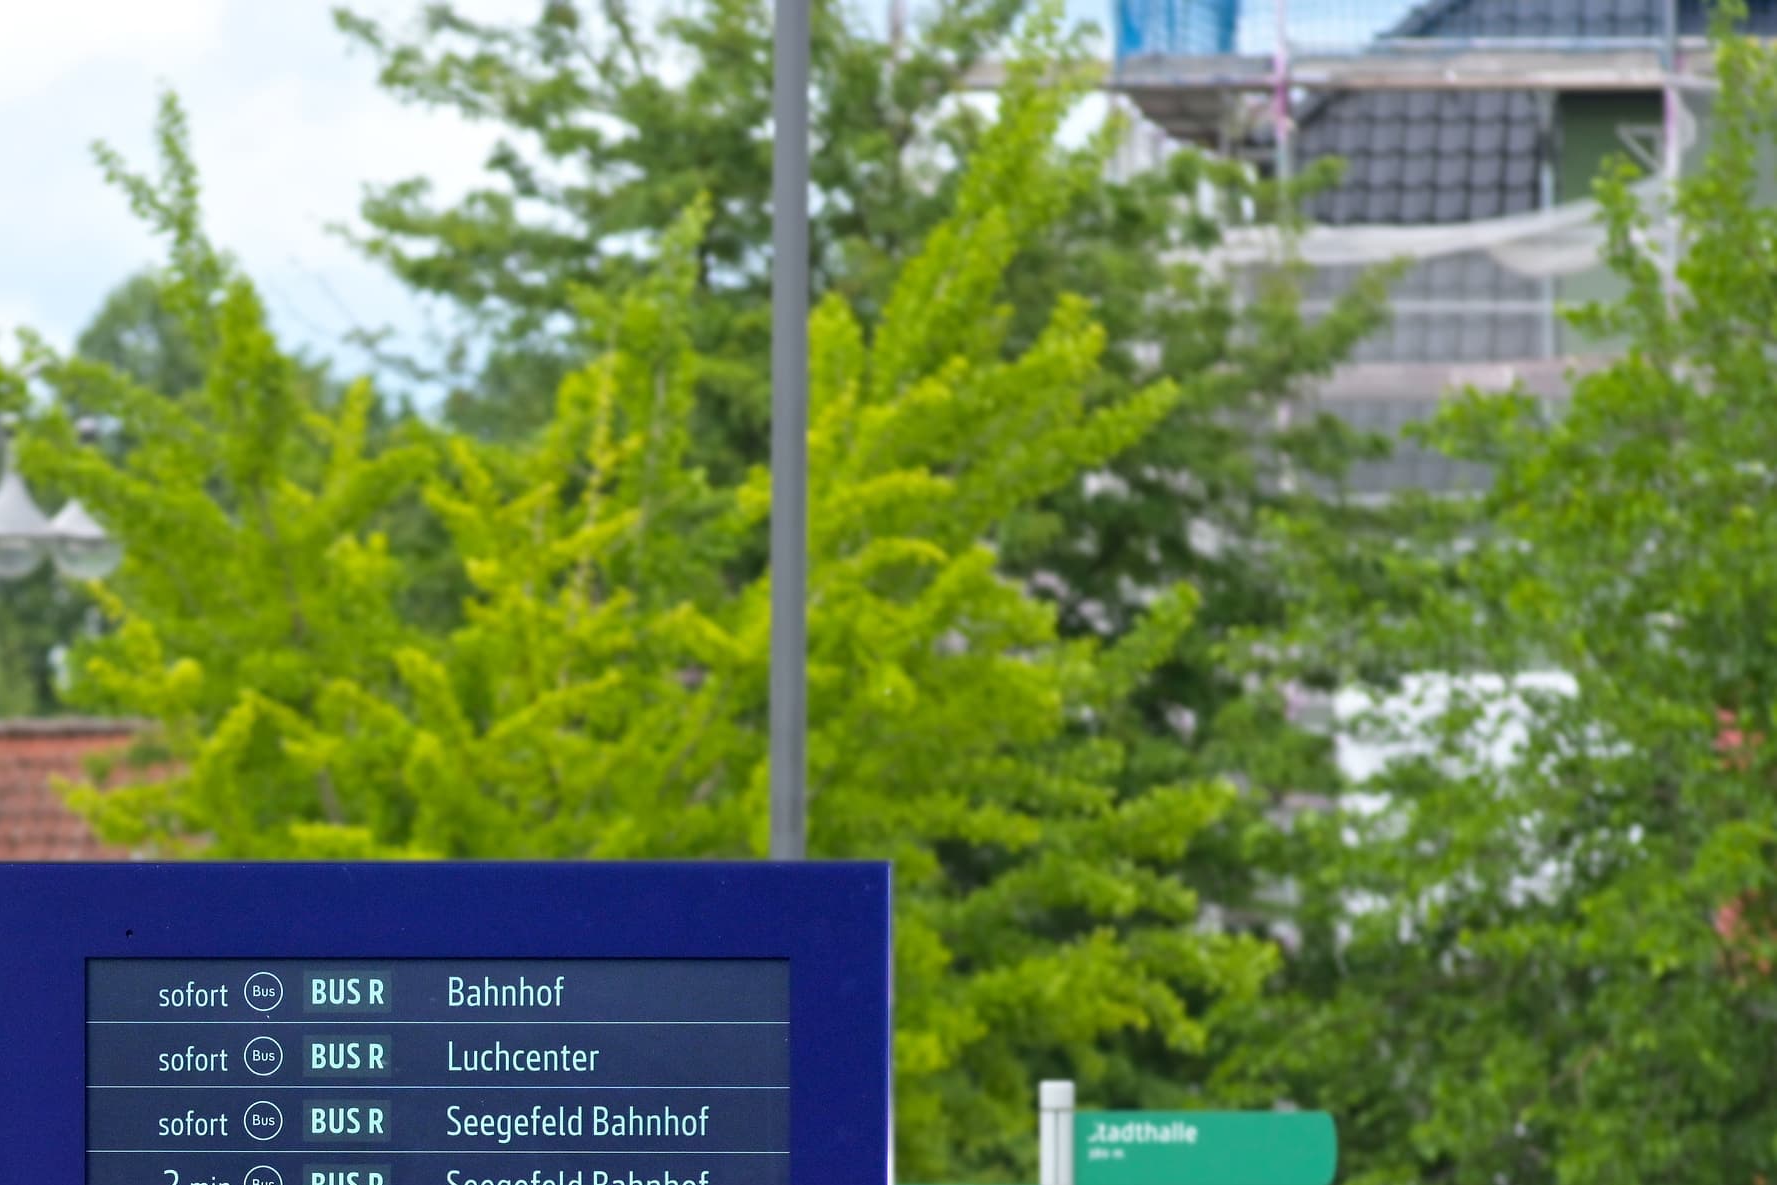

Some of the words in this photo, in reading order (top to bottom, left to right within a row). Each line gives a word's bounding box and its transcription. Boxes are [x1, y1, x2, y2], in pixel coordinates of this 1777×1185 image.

[158, 980, 228, 1008] sofort
[252, 985, 276, 998] Bus
[311, 978, 361, 1005] BUS
[368, 978, 385, 1005] R
[448, 975, 565, 1007] Bahnhof
[158, 1045, 228, 1072] sofort
[252, 1050, 276, 1062] Bus
[311, 1042, 361, 1070] BUS
[368, 1042, 385, 1070] R
[448, 1040, 600, 1072] Luchcenter
[158, 1109, 228, 1137] sofort
[252, 1114, 276, 1126] Bus
[311, 1107, 361, 1134] BUS
[368, 1107, 385, 1134] R
[446, 1105, 583, 1144] Seegefeld
[593, 1105, 710, 1137] Bahnhof
